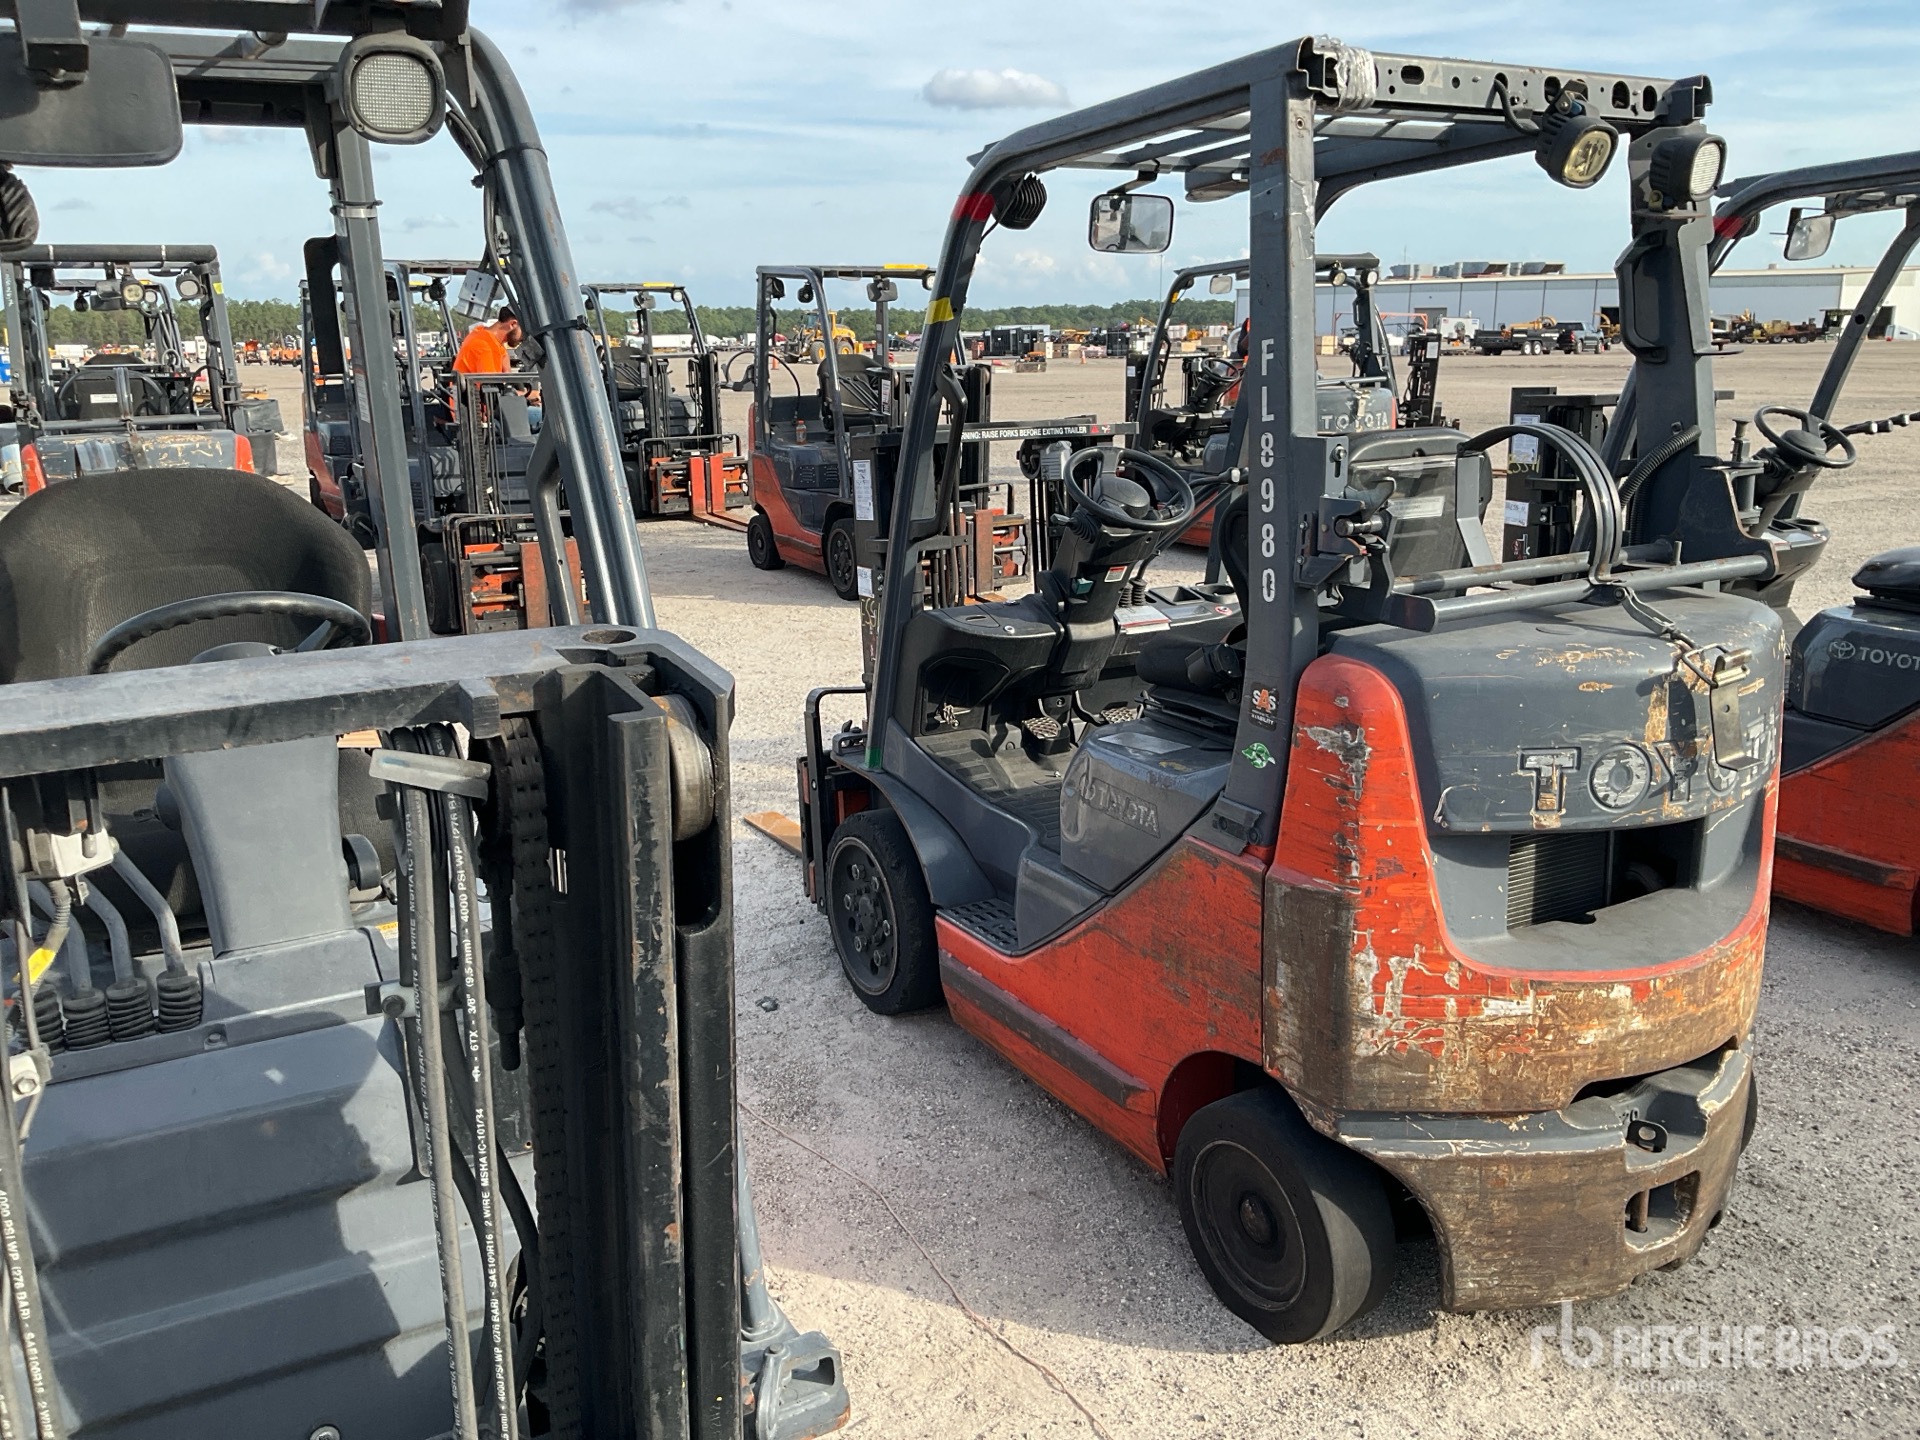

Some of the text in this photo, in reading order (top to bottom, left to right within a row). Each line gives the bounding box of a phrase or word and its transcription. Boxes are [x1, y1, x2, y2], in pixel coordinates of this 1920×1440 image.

[1320, 411, 1389, 431] TOYOTA
[961, 426, 1087, 441] RNING: RAISE FORKS BEFORE EXITING TRAILER
[1260, 338, 1276, 603] FL8980
[1859, 646, 1920, 671] TOYOT
[1252, 688, 1277, 714] SAS
[452, 812, 462, 839] (276
[456, 845, 465, 867] WP
[458, 869, 468, 891] PSI
[460, 893, 470, 922] 4000
[409, 918, 417, 950] WIRE
[463, 938, 473, 965] mm)
[465, 966, 475, 988] (9.5
[470, 1030, 479, 1051] 6TX
[476, 1108, 487, 1154] IC-101/34
[479, 1156, 490, 1187] MSHA
[482, 1191, 493, 1218] WIRE
[3, 1219, 16, 1239] PSI
[7, 1241, 20, 1261] WP
[487, 1233, 498, 1288] SAE100R16
[15, 1291, 30, 1320] BAR)
[490, 1298, 501, 1322] BAR)
[493, 1323, 502, 1343] (276
[494, 1346, 503, 1362] WP
[496, 1363, 505, 1380] PSI
[498, 1381, 507, 1402] 4000
[39, 1410, 56, 1439] WIRE
